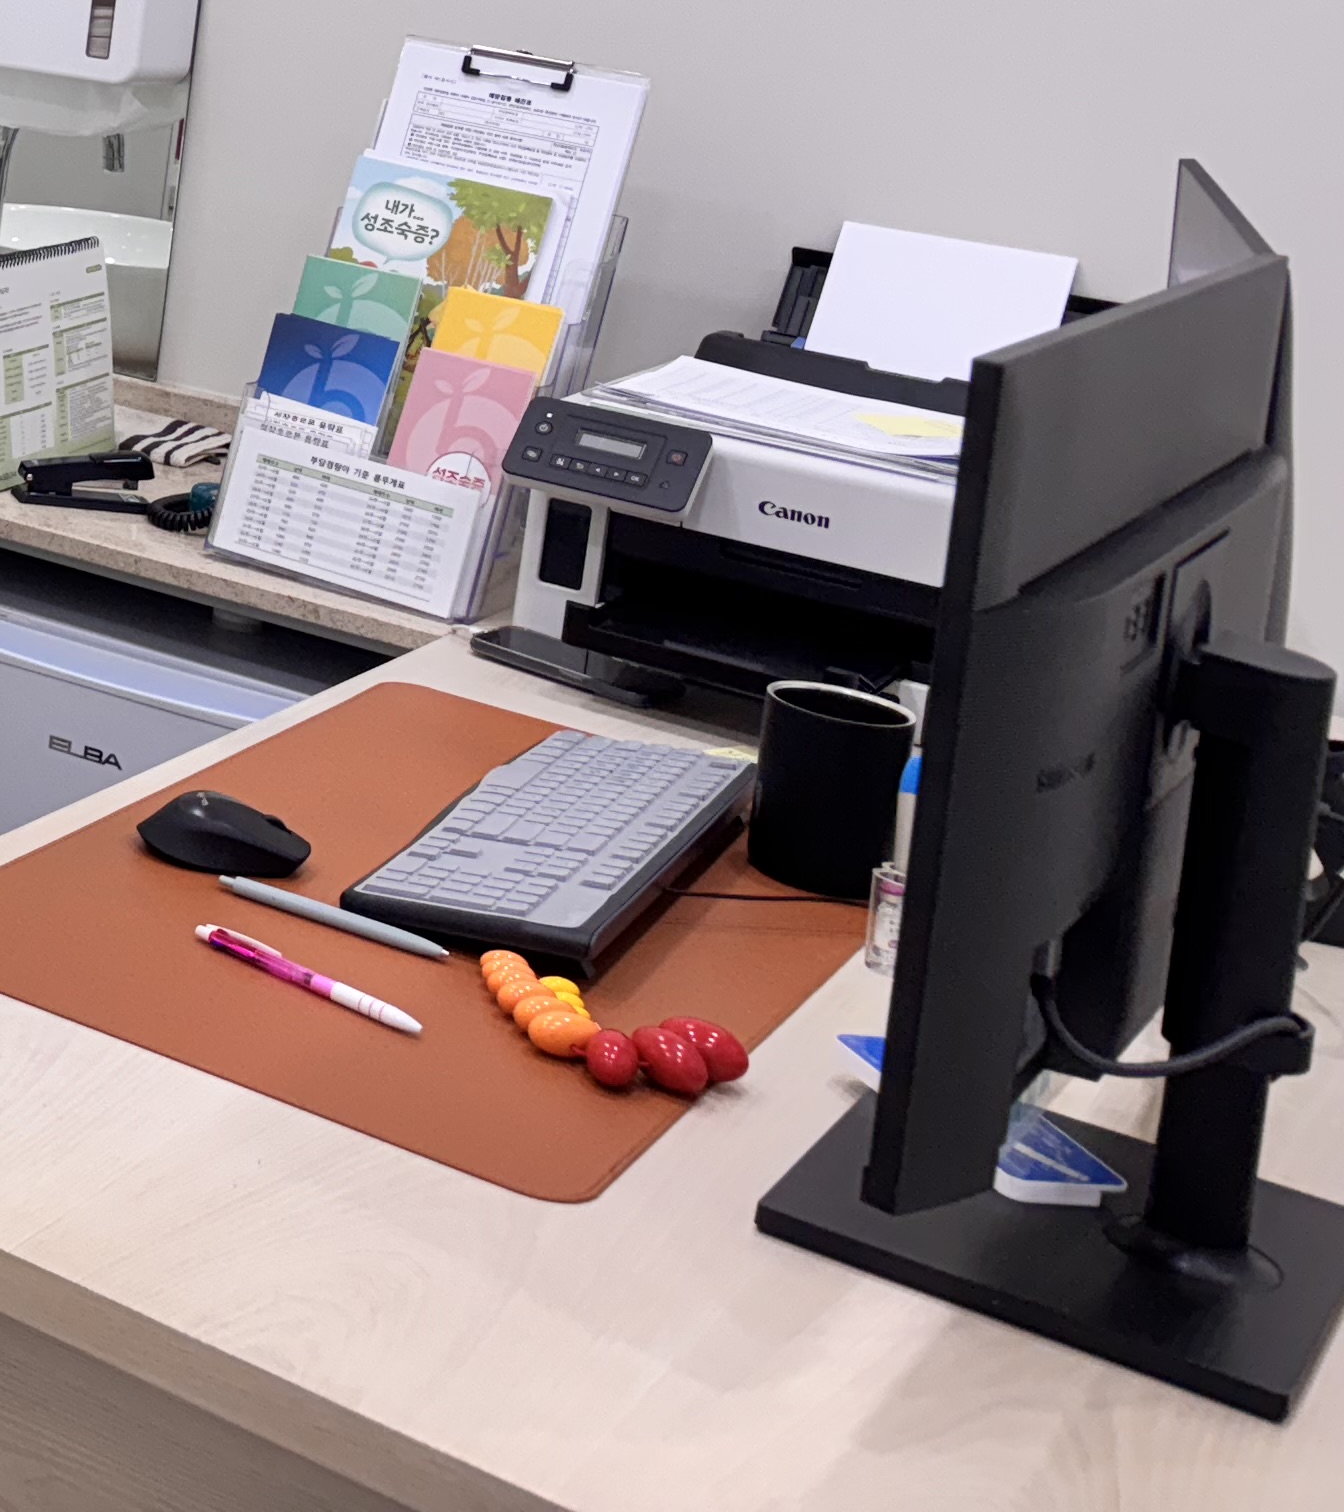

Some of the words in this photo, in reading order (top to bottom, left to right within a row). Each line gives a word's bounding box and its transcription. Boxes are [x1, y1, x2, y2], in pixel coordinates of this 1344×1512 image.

[360, 212, 440, 245] 성조숙증?
[353, 469, 370, 481] 기준
[758, 500, 831, 529] Canon
[48, 734, 123, 771] ELBA
